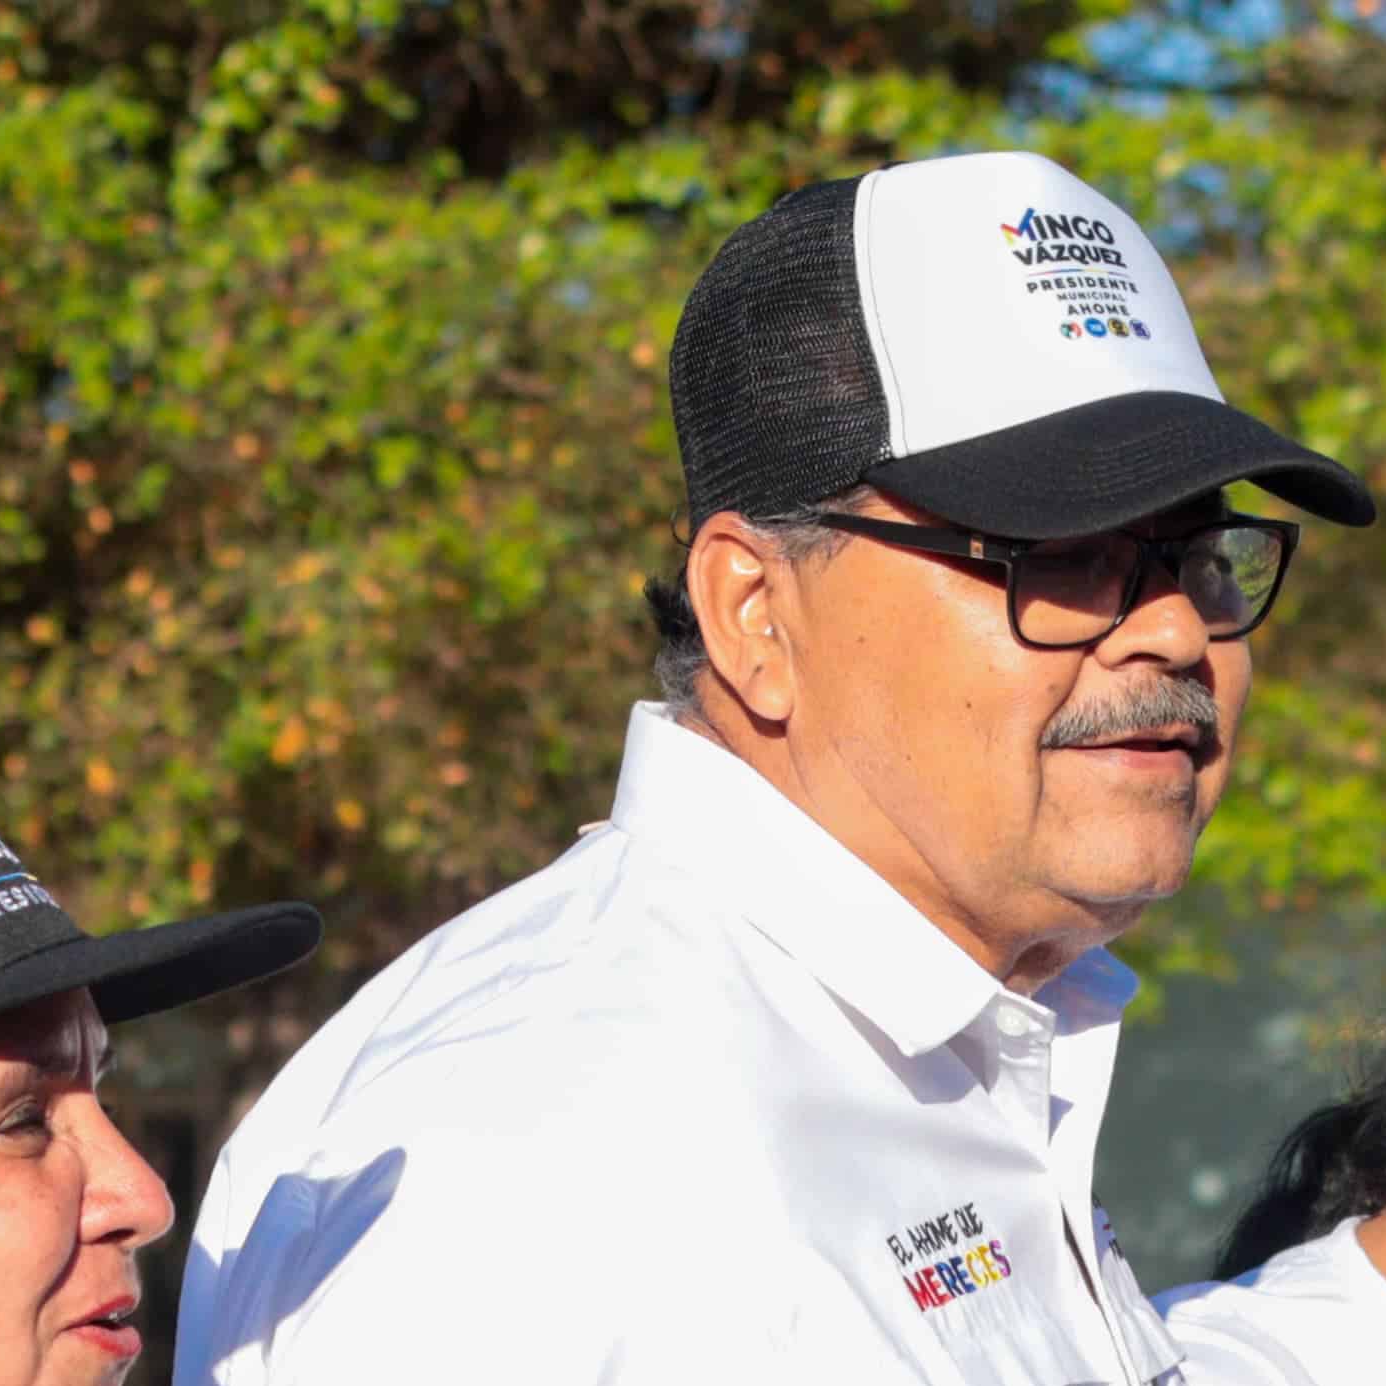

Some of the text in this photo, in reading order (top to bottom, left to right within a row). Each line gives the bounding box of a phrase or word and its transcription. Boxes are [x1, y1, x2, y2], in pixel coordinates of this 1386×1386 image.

[1001, 207, 1114, 245] MINGO
[1013, 241, 1127, 269] VÁZQUEZ
[1027, 276, 1139, 294] PRESIDENTE
[1057, 292, 1126, 302] MUNICIPAL
[1068, 303, 1130, 316] AHOME
[886, 1202, 983, 1266] EL AHOME QUE
[902, 1239, 1011, 1312] MERECES
